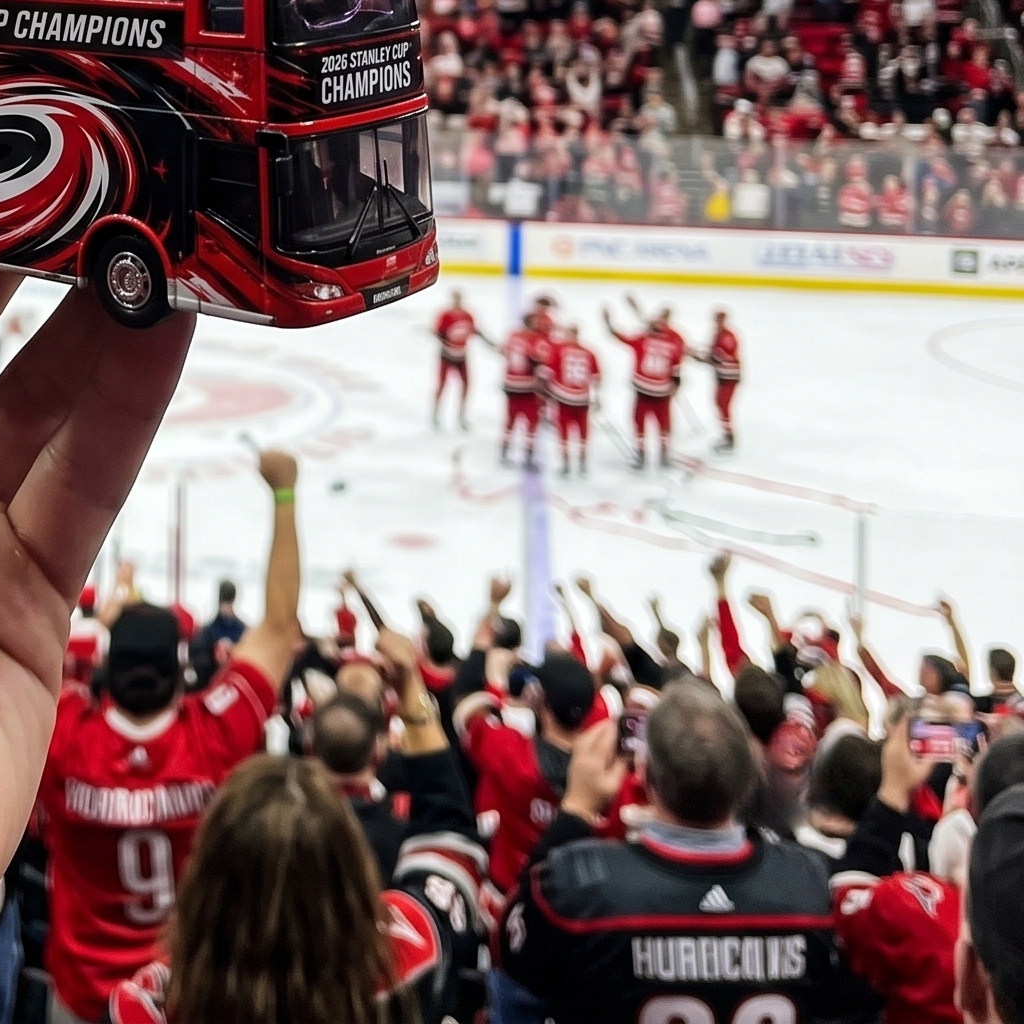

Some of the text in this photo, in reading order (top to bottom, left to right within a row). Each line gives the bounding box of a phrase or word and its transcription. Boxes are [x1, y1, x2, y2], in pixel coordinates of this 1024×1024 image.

[13, 9, 166, 50] CHAMPIONS
[321, 41, 409, 73] 2026 STANLEY CUP
[321, 60, 411, 104] CHAMPIONS
